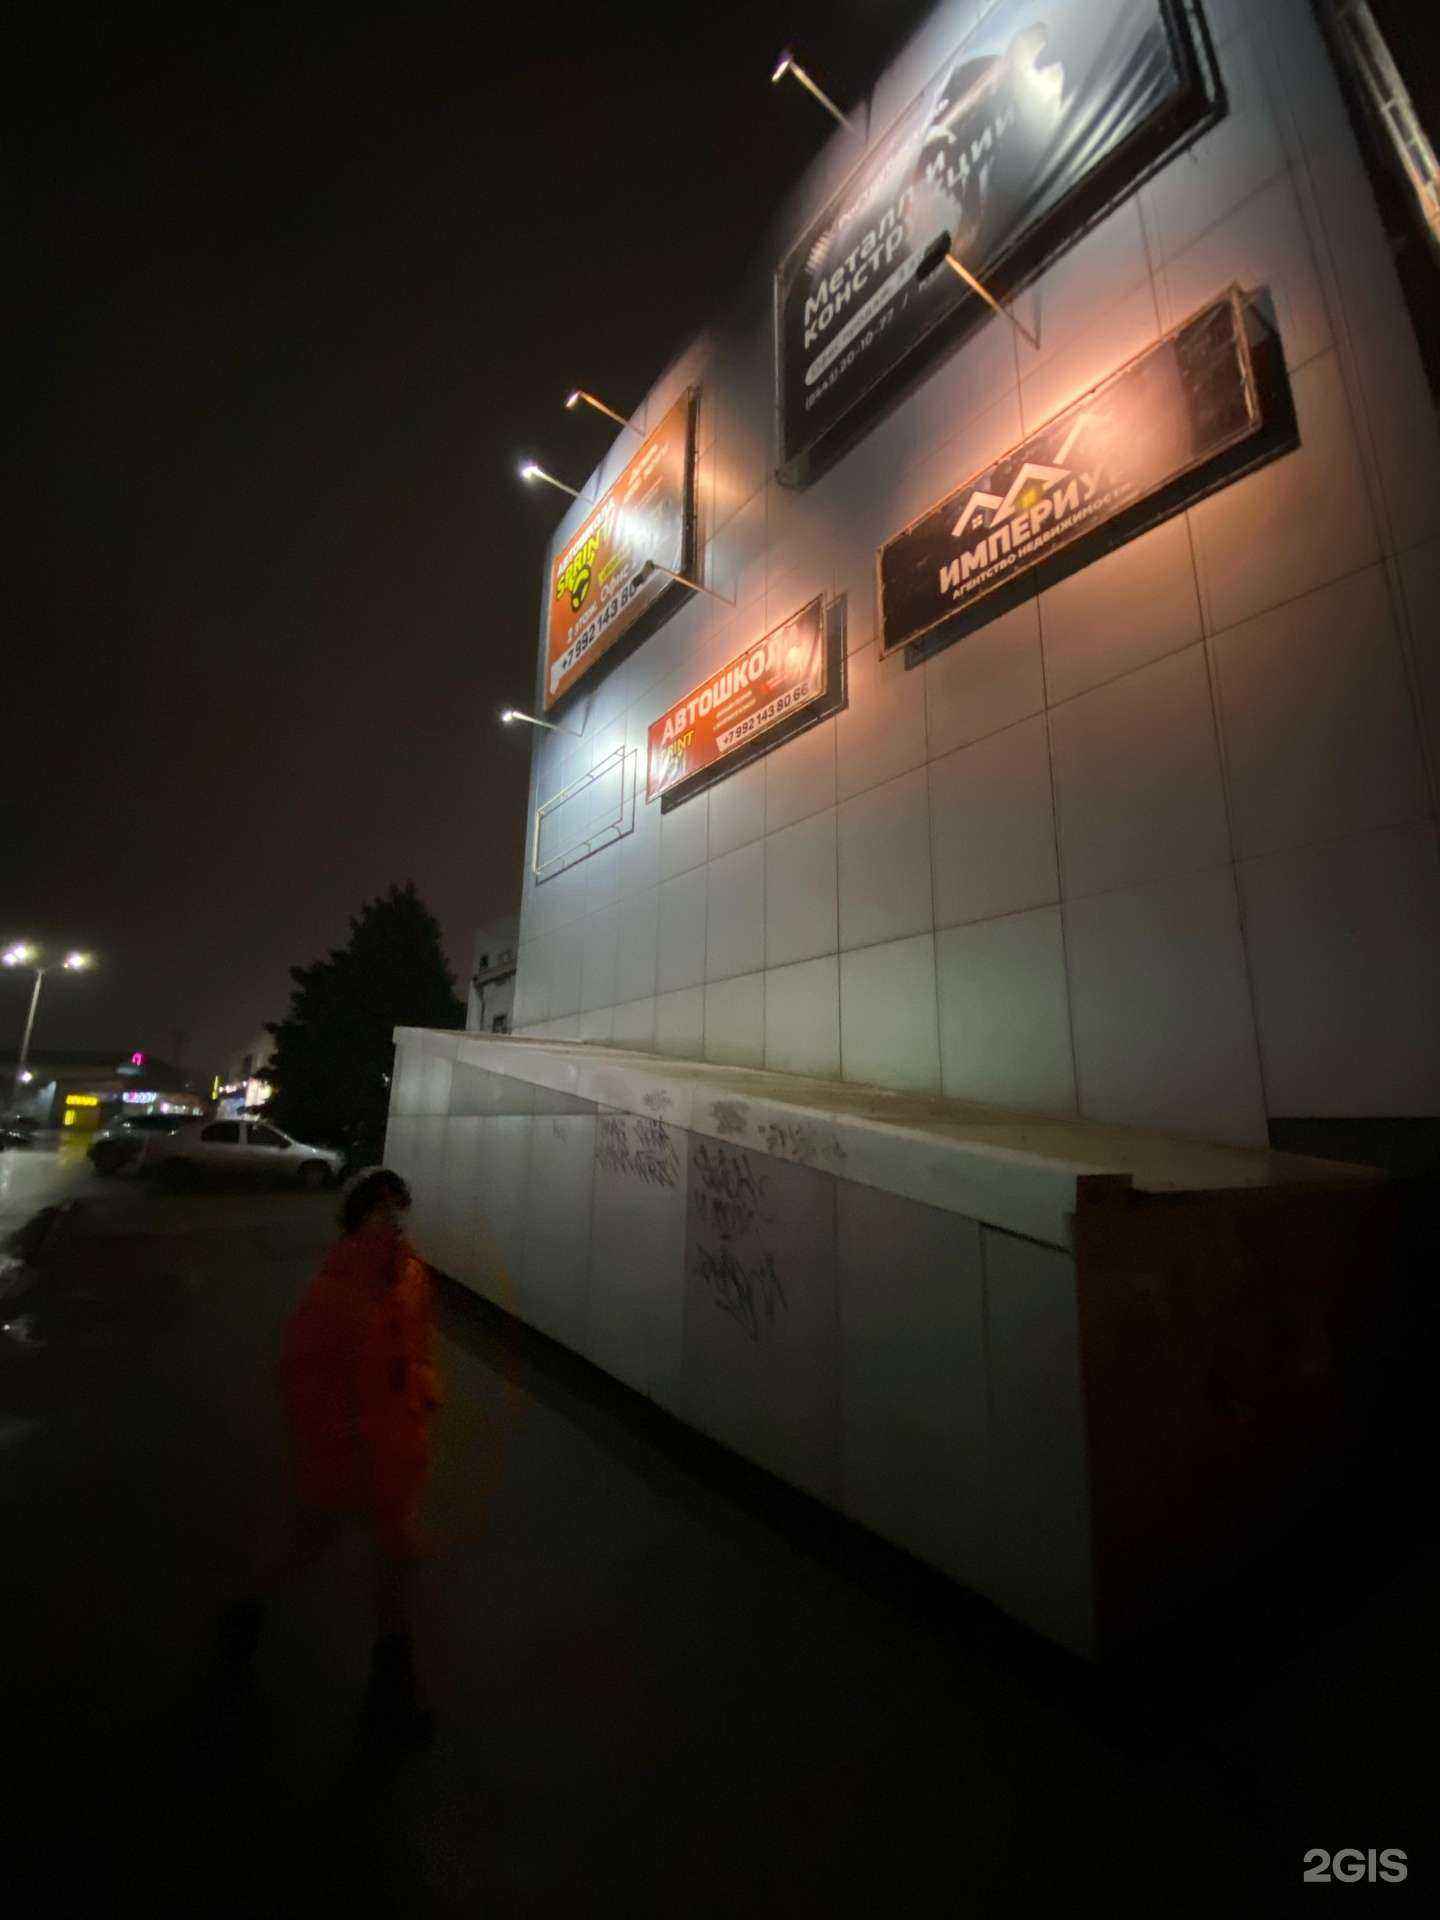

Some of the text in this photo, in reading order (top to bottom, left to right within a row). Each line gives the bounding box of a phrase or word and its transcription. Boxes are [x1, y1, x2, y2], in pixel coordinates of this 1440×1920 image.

[939, 464, 1106, 594] ИМПЕРИУ
[735, 718, 754, 739] 992
[757, 706, 775, 724] 143
[776, 697, 791, 714] 80
